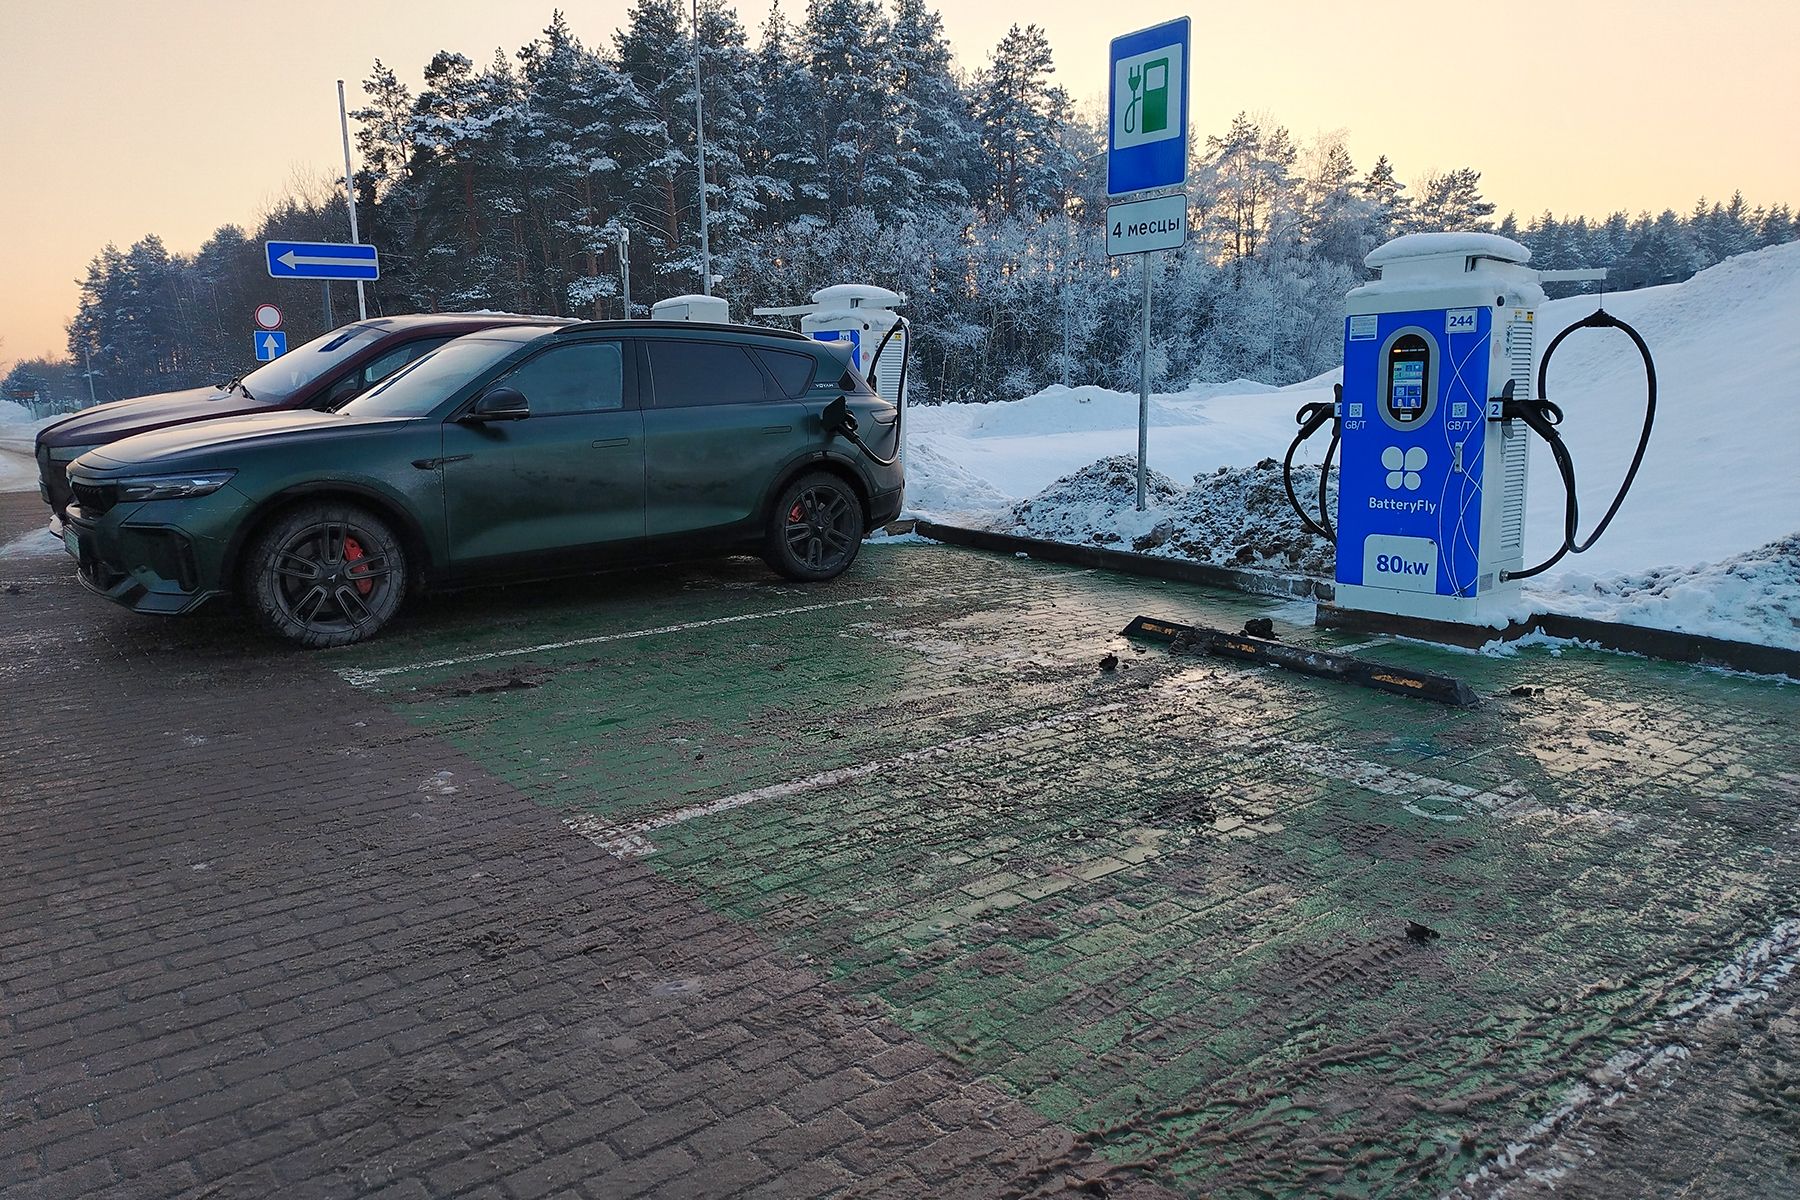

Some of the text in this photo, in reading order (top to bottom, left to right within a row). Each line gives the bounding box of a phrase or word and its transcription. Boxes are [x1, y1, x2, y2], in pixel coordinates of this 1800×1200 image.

[1112, 218, 1180, 238] 4 месцы
[1449, 315, 1473, 327] 244
[1491, 404, 1499, 415] 2
[1345, 420, 1366, 430] GB/T
[1447, 420, 1472, 431] GB/T
[1368, 497, 1437, 514] BatteryFly
[1376, 554, 1429, 576] 80kW
